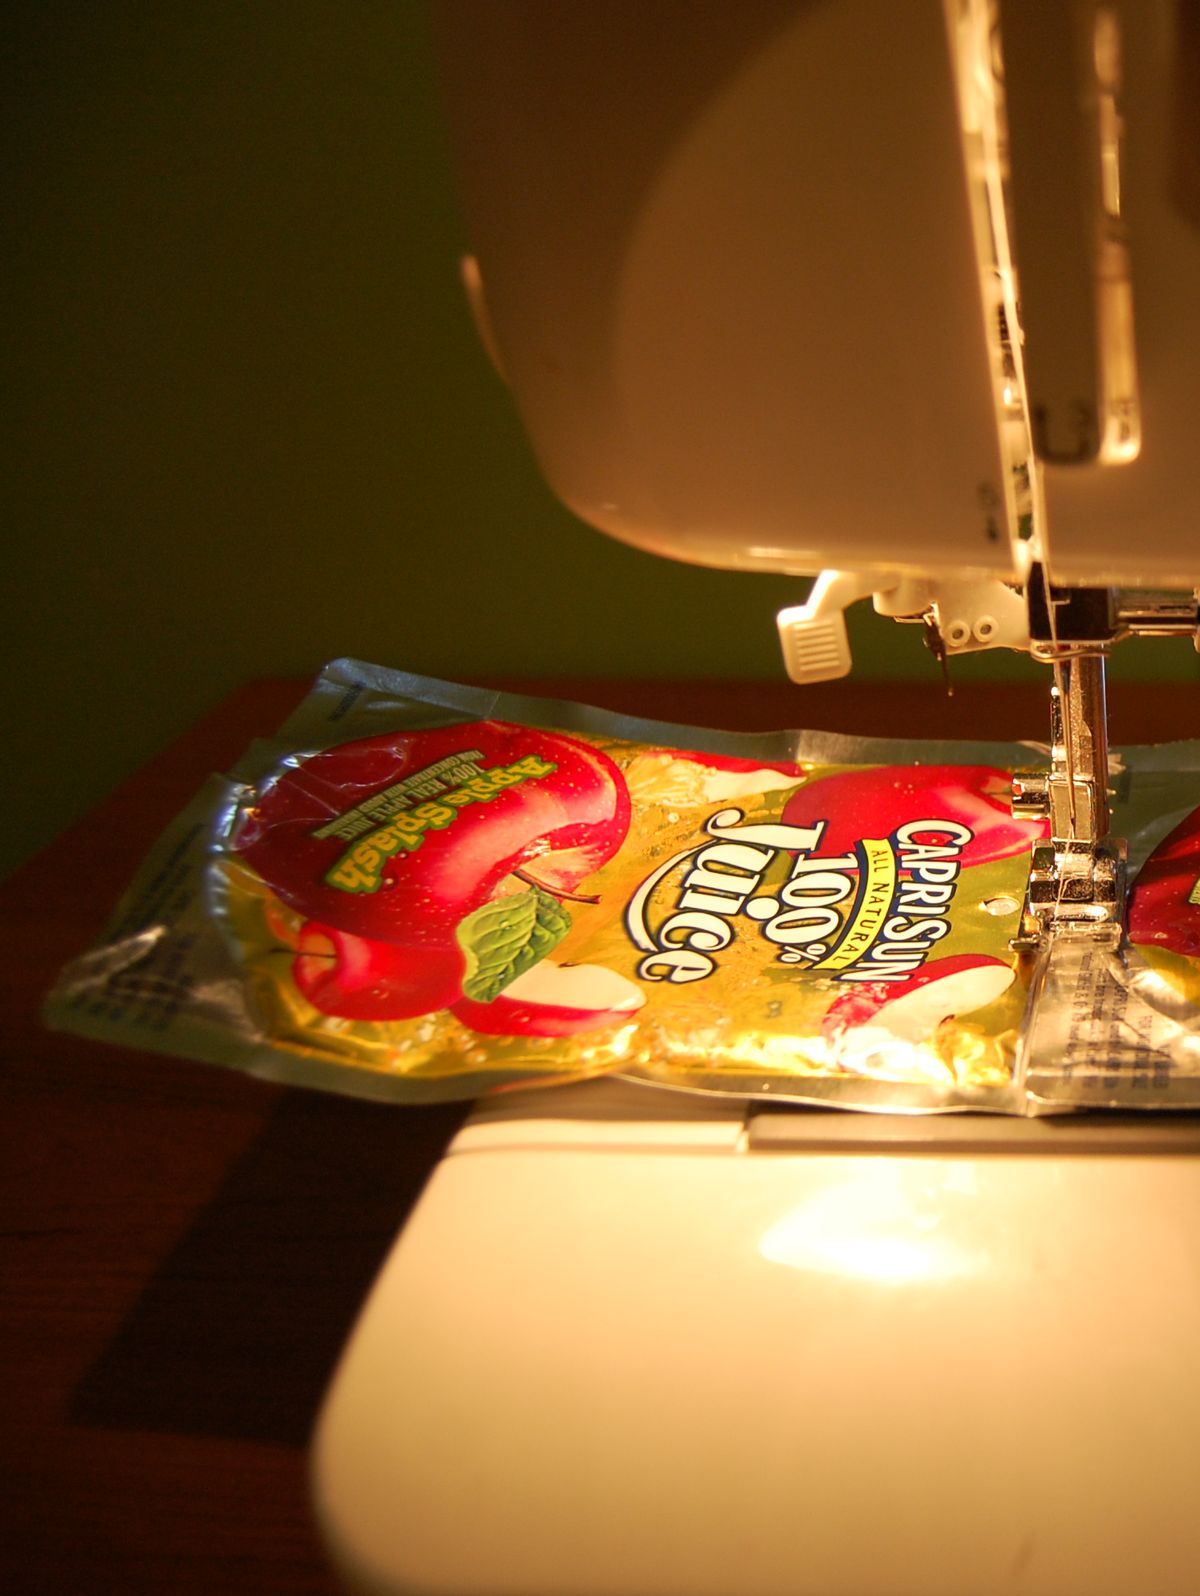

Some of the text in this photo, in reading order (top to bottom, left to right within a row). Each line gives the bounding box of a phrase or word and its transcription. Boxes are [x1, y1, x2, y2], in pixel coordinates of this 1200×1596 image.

[331, 755, 556, 890] Apple Splash
[339, 761, 485, 841] 100% REAL APPLE JUICE
[637, 807, 827, 983] Juice
[763, 852, 859, 967] 100%
[833, 849, 891, 961] ALL NATURAL
